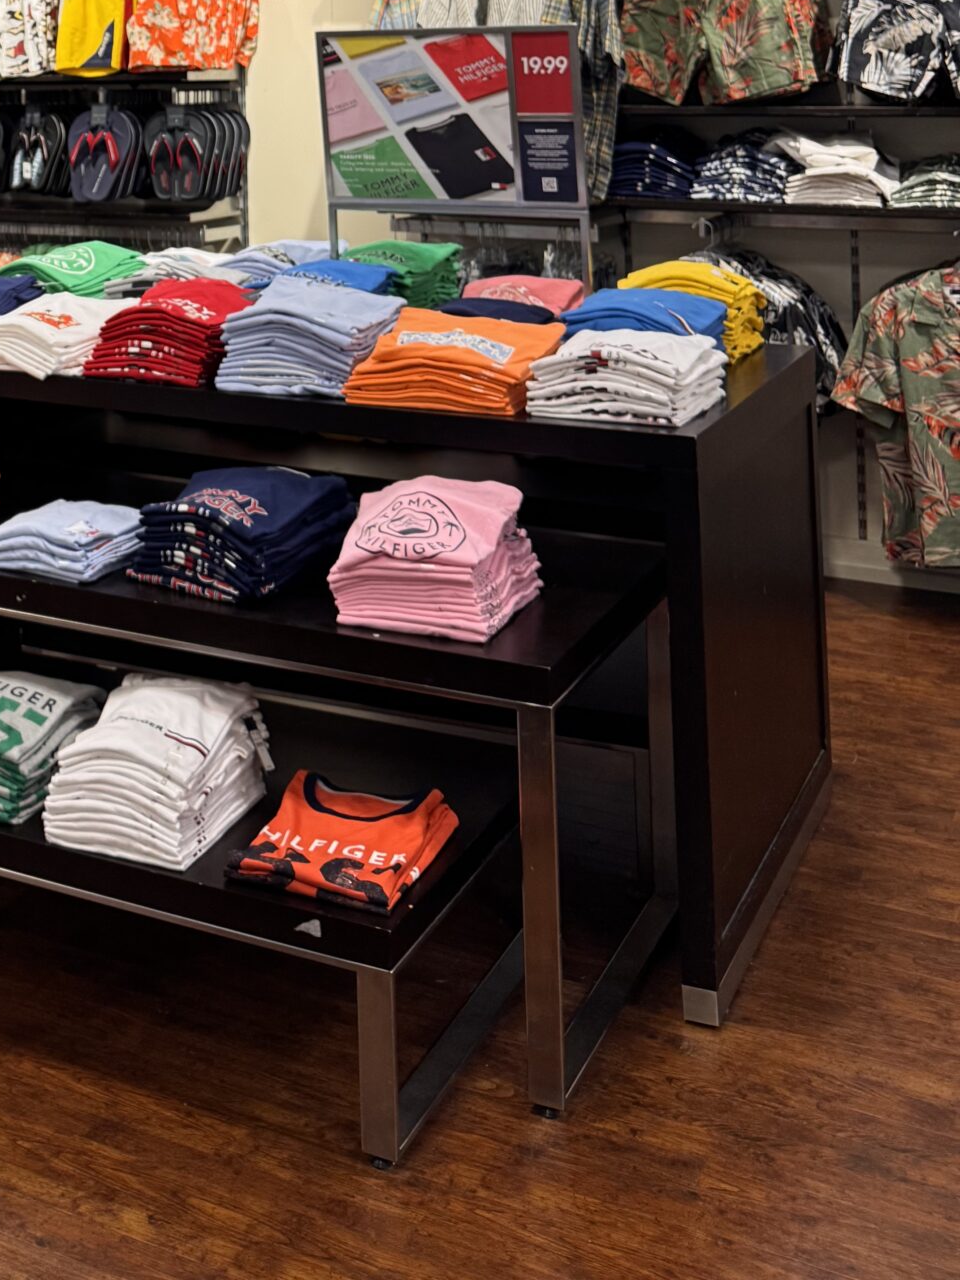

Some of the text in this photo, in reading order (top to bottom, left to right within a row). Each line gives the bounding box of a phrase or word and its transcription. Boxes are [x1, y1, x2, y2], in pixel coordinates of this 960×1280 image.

[454, 56, 496, 75] TOMMY
[521, 55, 568, 75] 19.99
[363, 172, 408, 192] TOMMY
[382, 497, 450, 519] TOMMY
[365, 537, 452, 557] HILFIGER
[260, 825, 408, 867] HILFIGER
